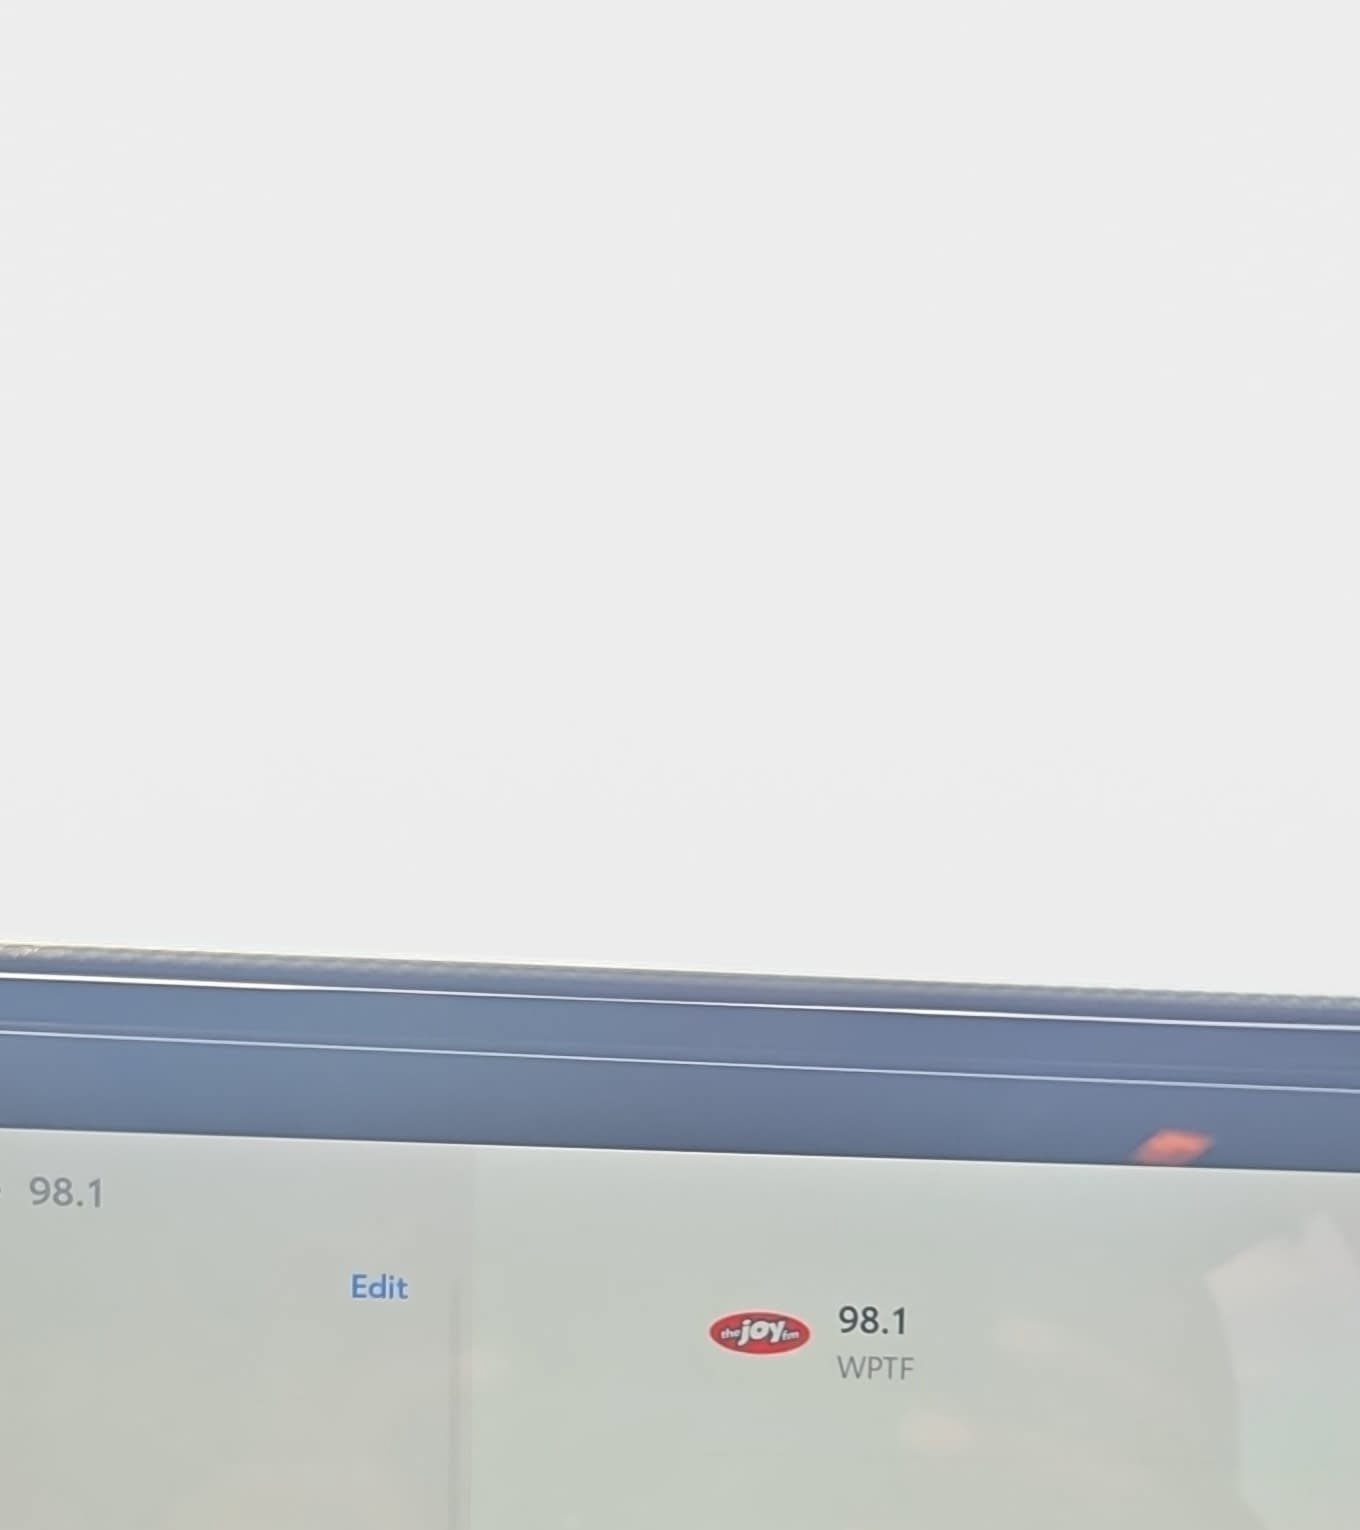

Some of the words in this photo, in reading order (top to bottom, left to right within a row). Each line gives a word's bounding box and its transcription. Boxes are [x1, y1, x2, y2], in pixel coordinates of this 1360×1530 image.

[28, 1176, 104, 1209] 98.1
[351, 1274, 409, 1300] Edit
[839, 1306, 907, 1334] 98.1
[837, 1355, 914, 1380] WPTF
